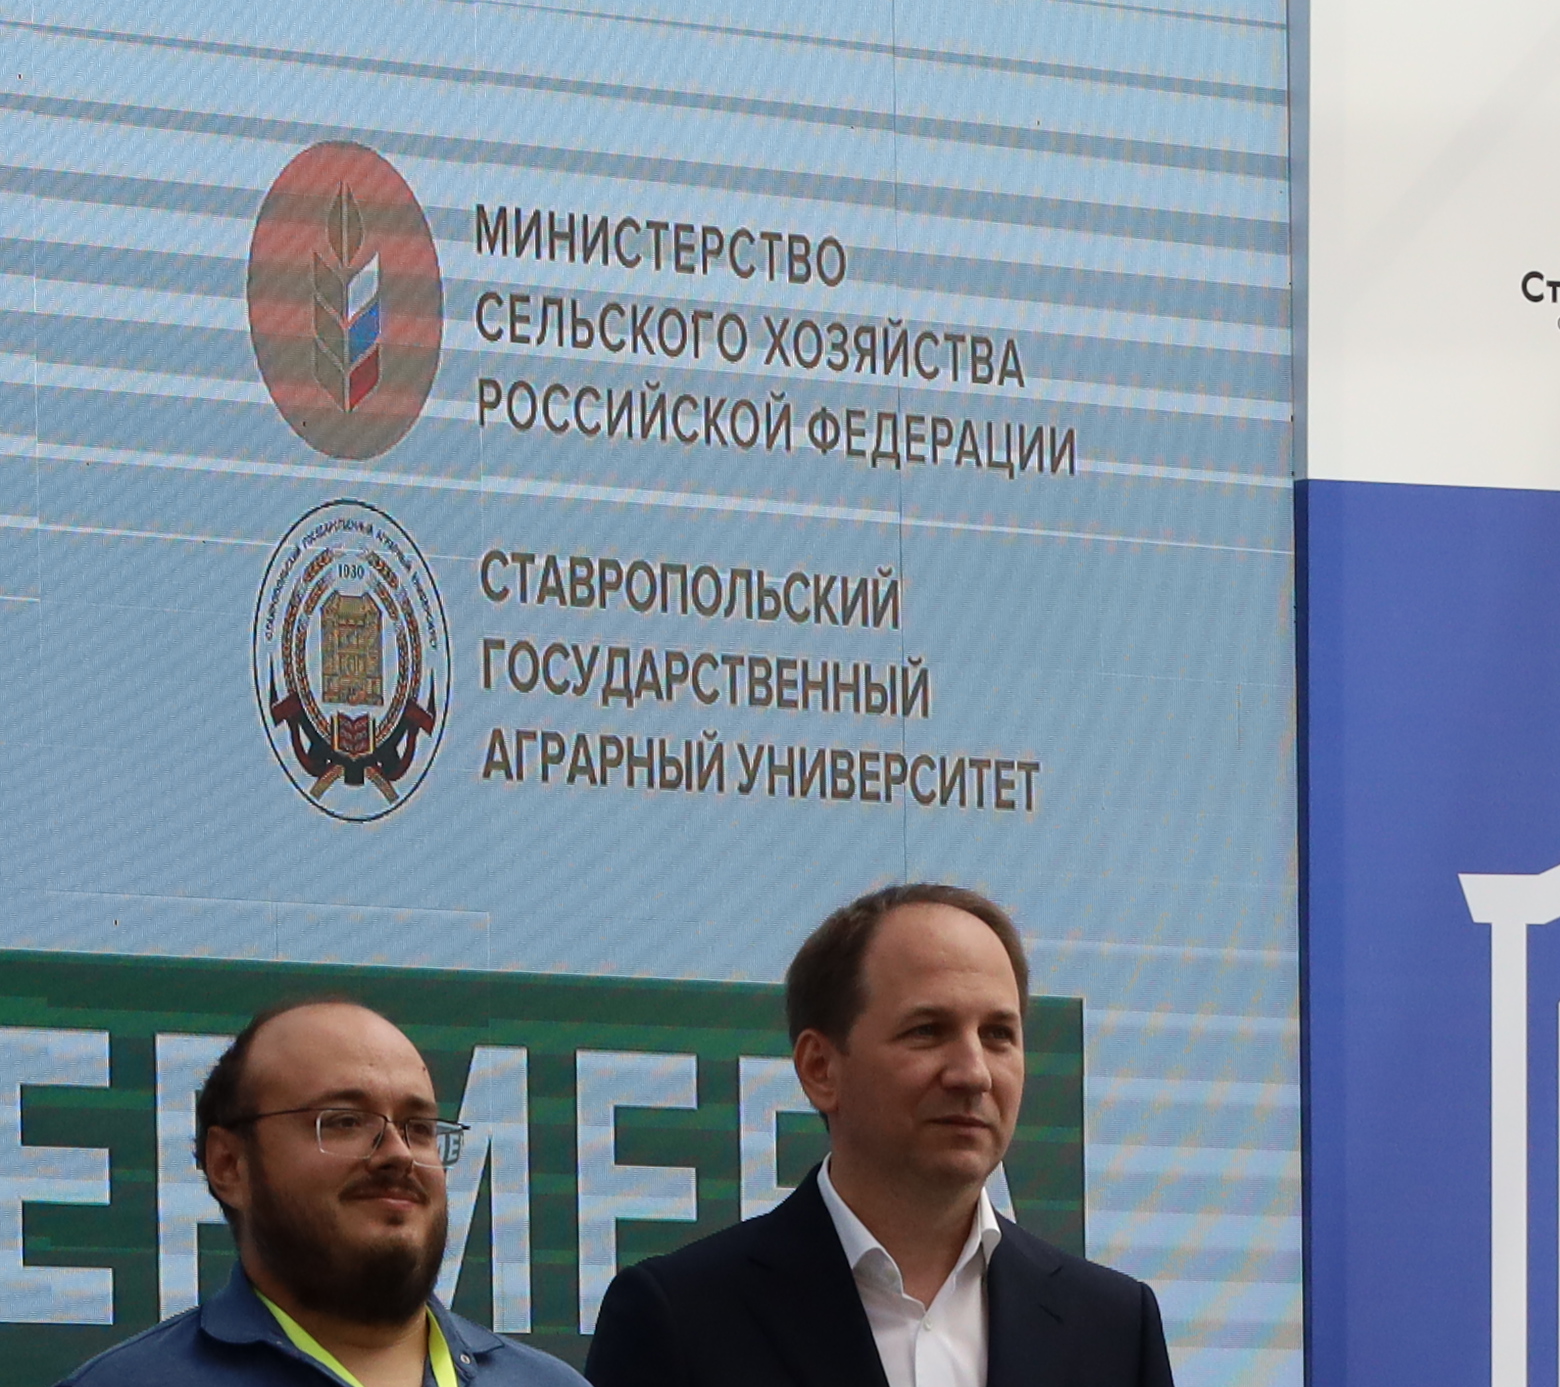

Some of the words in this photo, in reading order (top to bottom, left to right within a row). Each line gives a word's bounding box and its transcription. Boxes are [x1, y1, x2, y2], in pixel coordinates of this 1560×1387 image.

[474, 204, 847, 288] МИНИСТЕРСТВО
[475, 292, 748, 364] СЕЛЬСКОГО
[763, 315, 1027, 388] ХОЗЯЙСТВА
[477, 379, 792, 453] РОССИЙСКОЙ
[808, 402, 1078, 480] ФЕДЕРАЦИИ
[480, 549, 901, 630] СТАВРОПОЛЬСКИЙ
[481, 637, 930, 718] ГОСУДАРСТВЕННЫЙ
[481, 728, 725, 793] АГРАРНЫЙ
[736, 741, 1041, 812] УНИВЕРСИТЕТ
